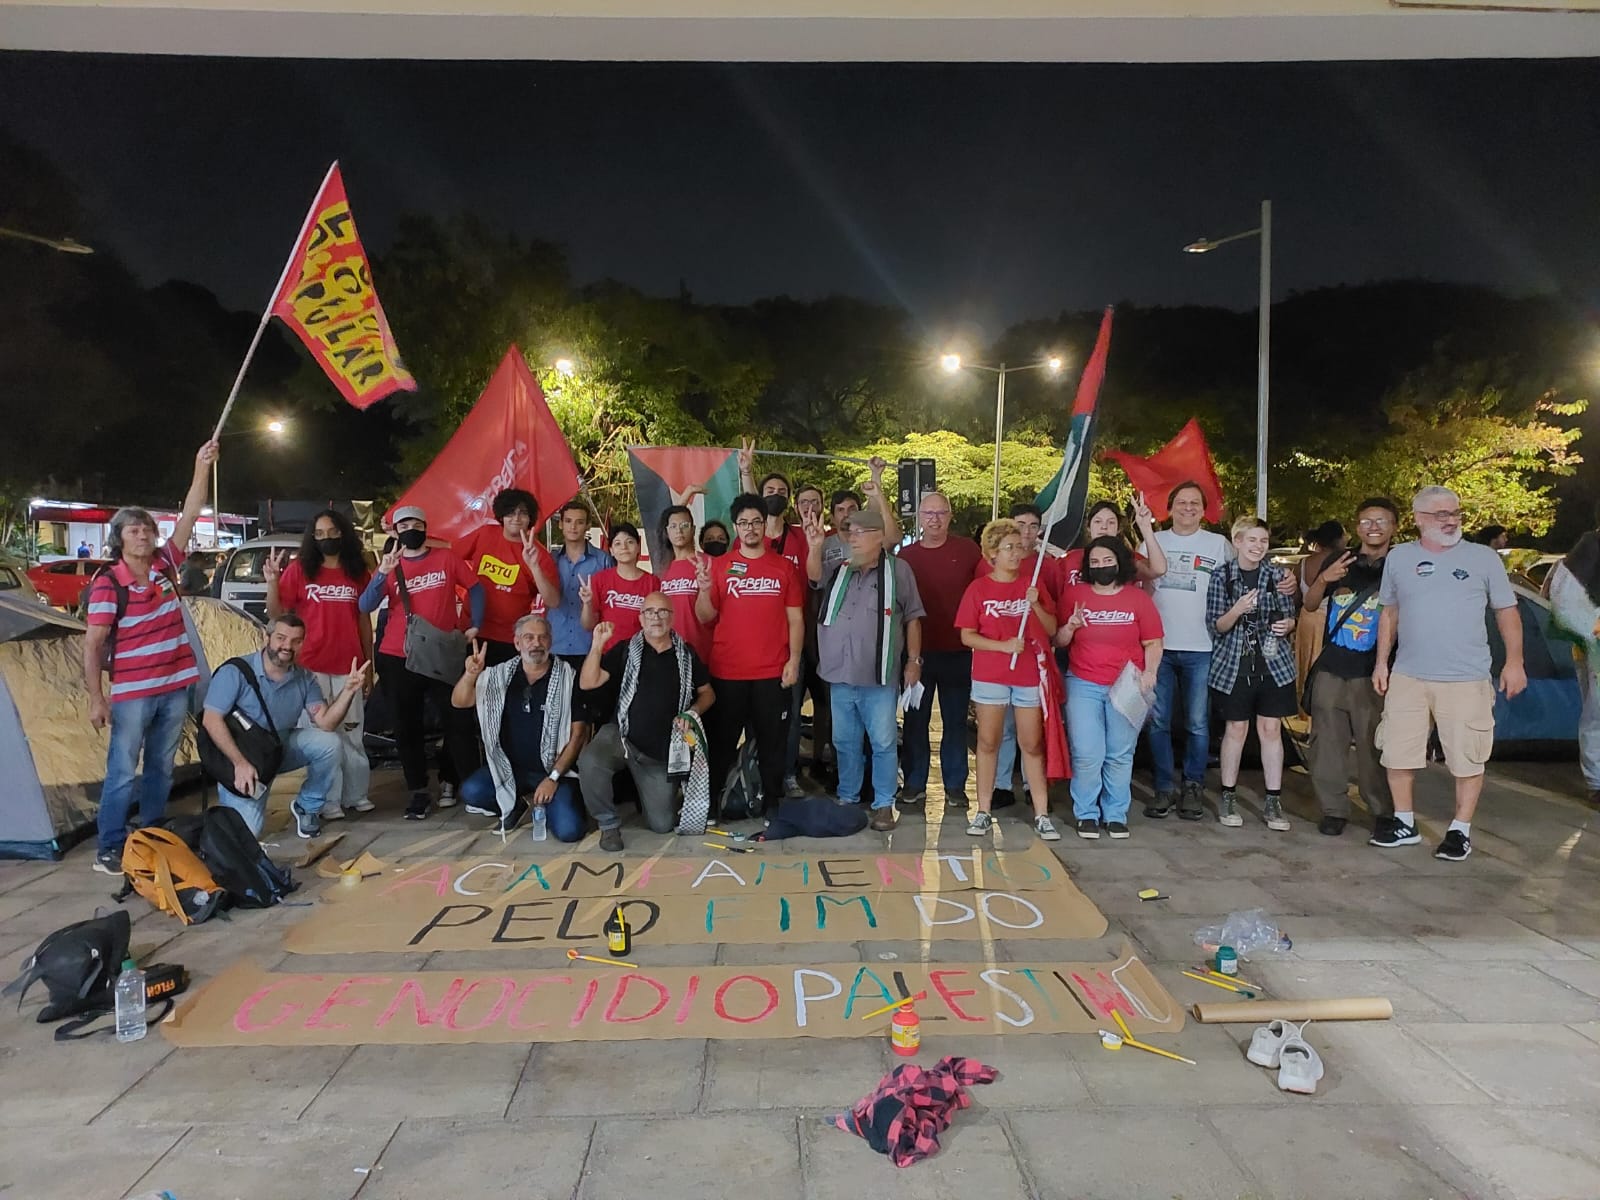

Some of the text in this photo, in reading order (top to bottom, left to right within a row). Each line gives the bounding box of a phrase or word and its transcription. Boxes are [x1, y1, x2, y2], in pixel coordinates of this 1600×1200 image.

[483, 561, 513, 579] PSTU
[604, 589, 645, 609] REBELD
[726, 576, 781, 599] REBELDIA
[379, 854, 1051, 897] ACAMPAMENTO
[407, 899, 660, 945] PELO
[705, 895, 877, 933] FIM
[913, 893, 1044, 929] DO
